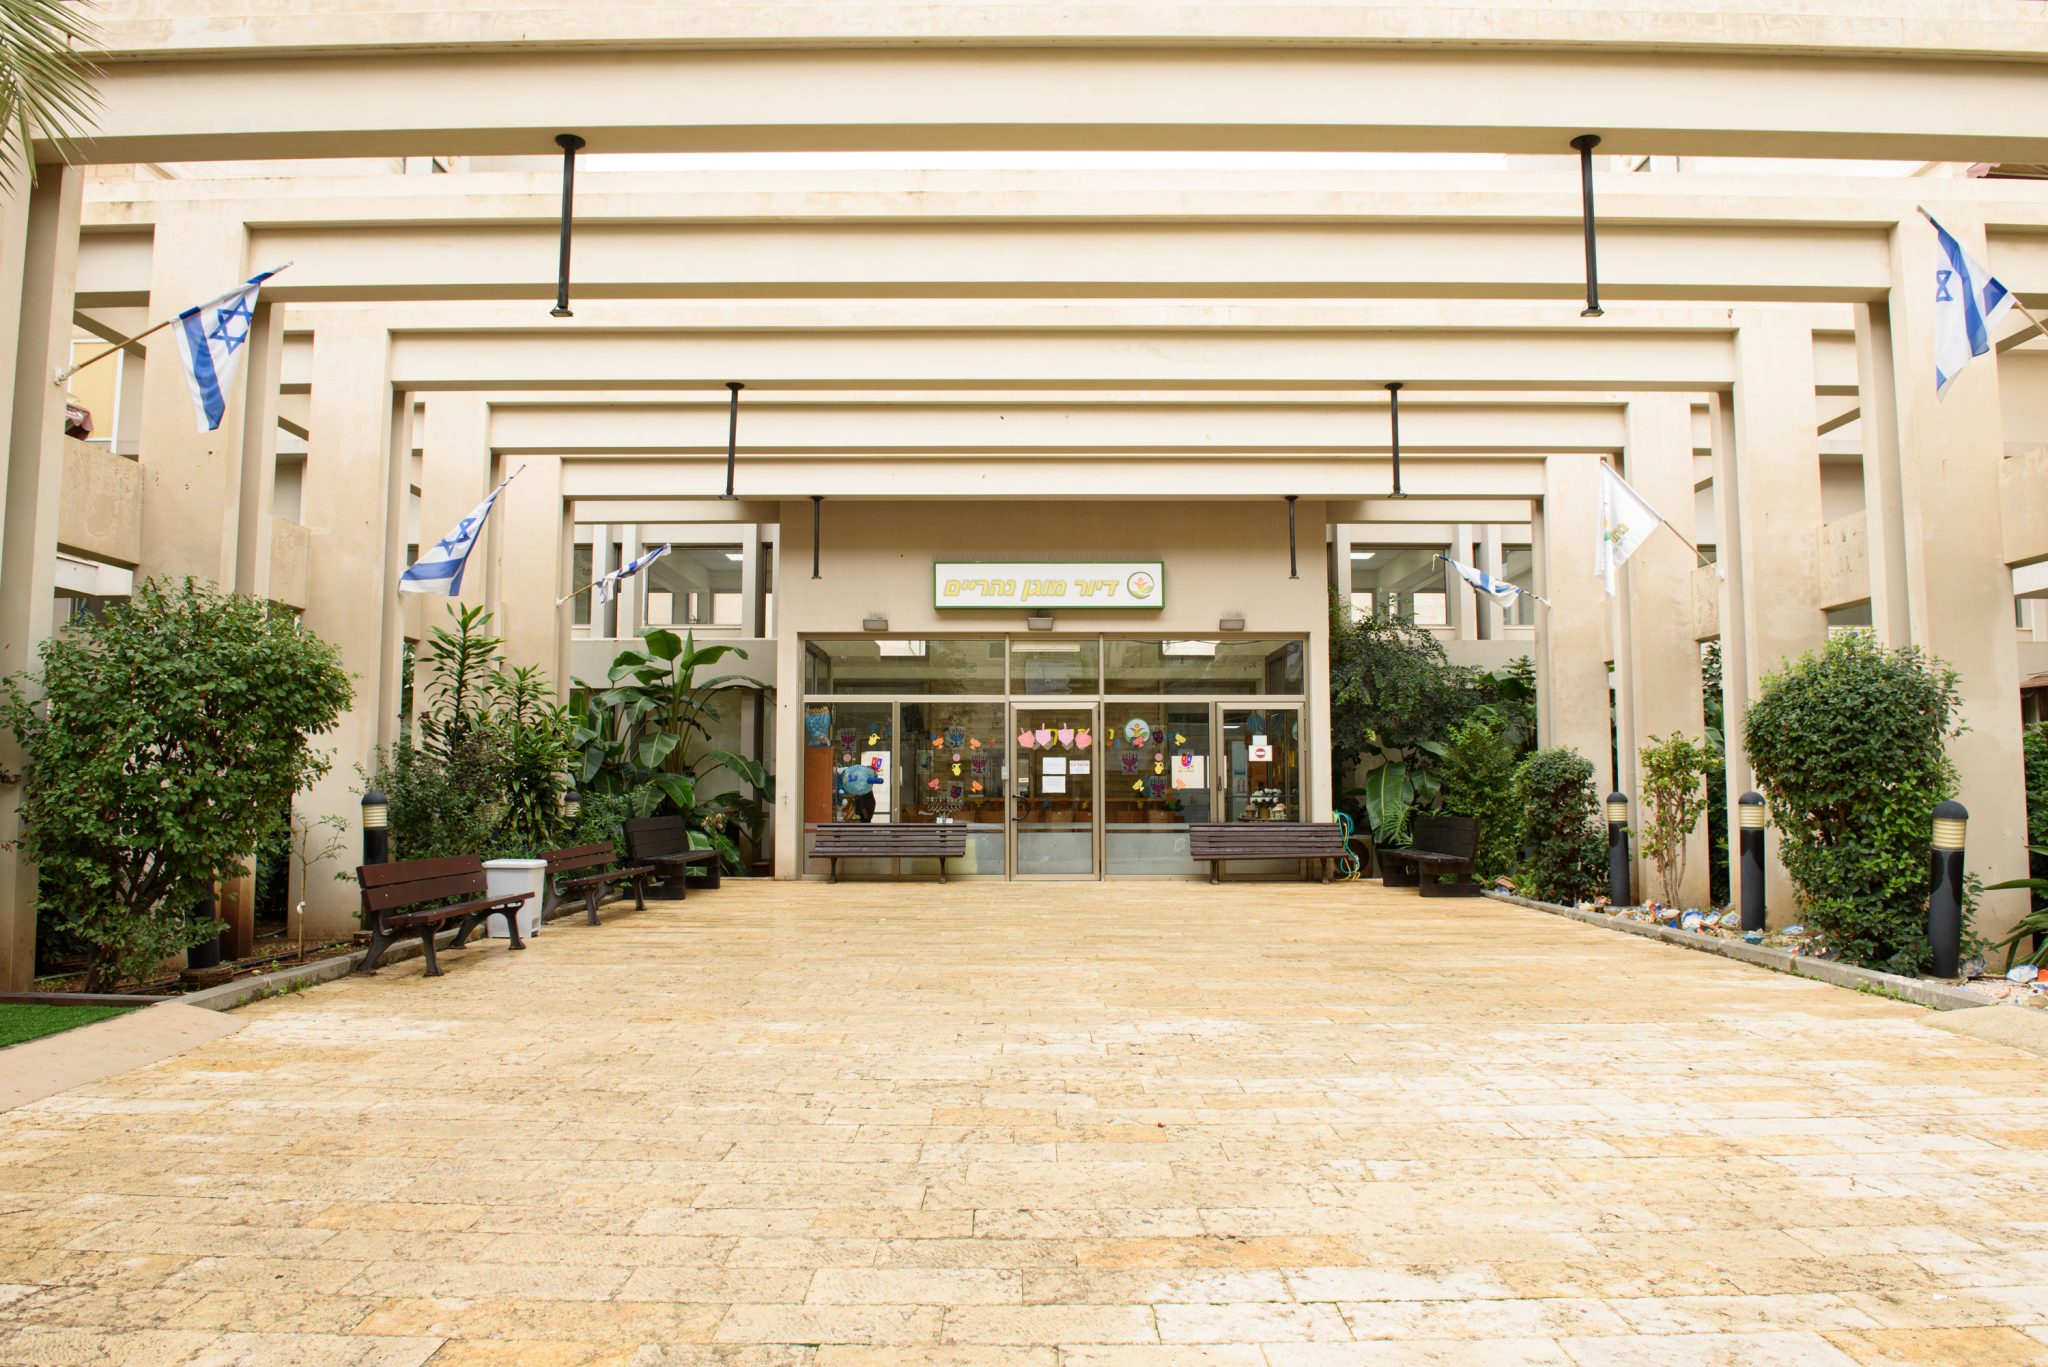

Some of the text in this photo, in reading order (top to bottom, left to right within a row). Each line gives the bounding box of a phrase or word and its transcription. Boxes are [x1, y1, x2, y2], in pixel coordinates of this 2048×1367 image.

[943, 579, 1120, 602] דיור מוגן נהריים
